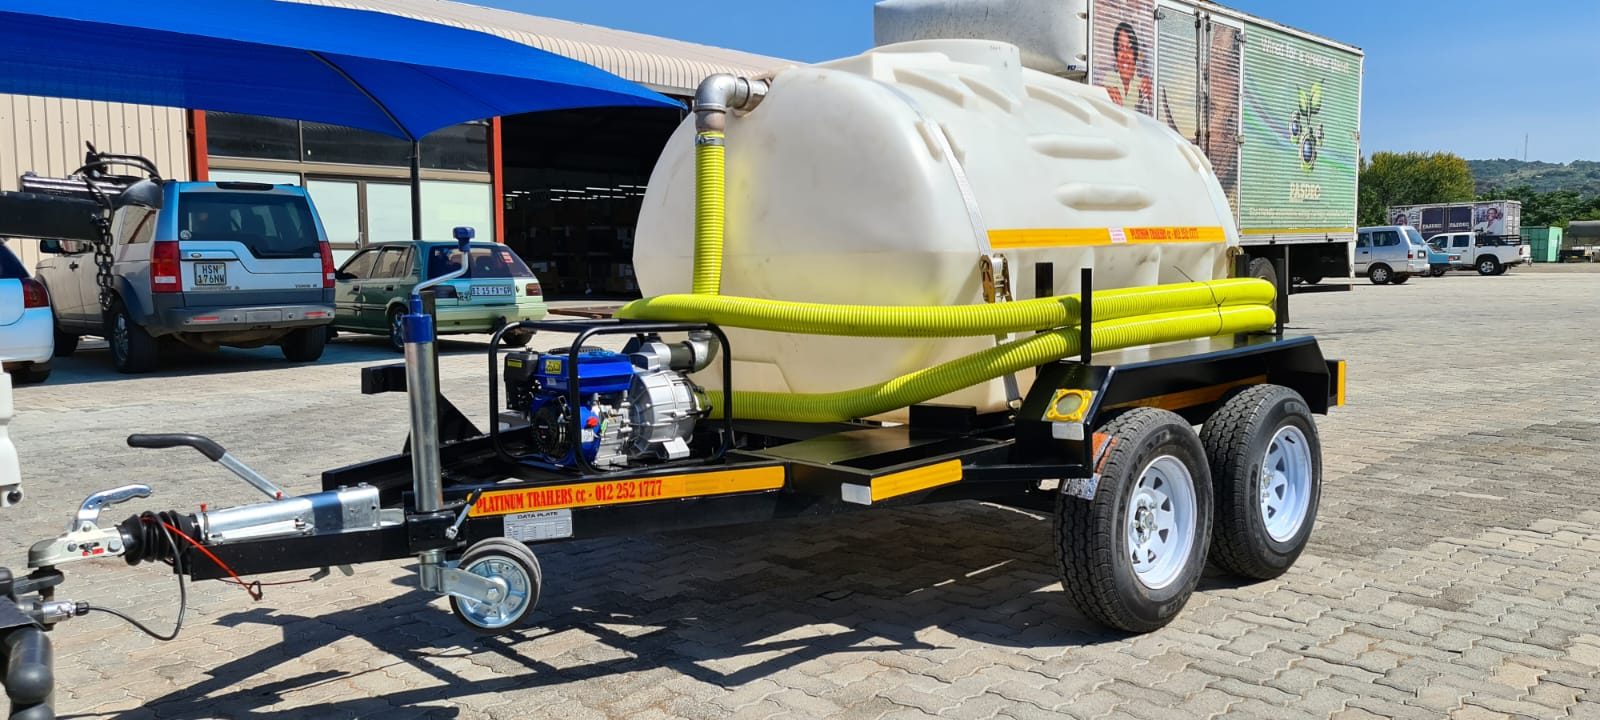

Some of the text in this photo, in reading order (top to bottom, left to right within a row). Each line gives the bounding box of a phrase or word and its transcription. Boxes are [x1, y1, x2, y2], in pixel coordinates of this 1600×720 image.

[202, 264, 218, 274] HSN
[197, 274, 224, 284] 176NW
[476, 492, 524, 513] PLATINUM
[527, 487, 573, 508] TRAILERS
[575, 488, 586, 503] cc
[595, 484, 614, 501] 012
[616, 482, 636, 498] 252
[639, 480, 662, 497] 1777
